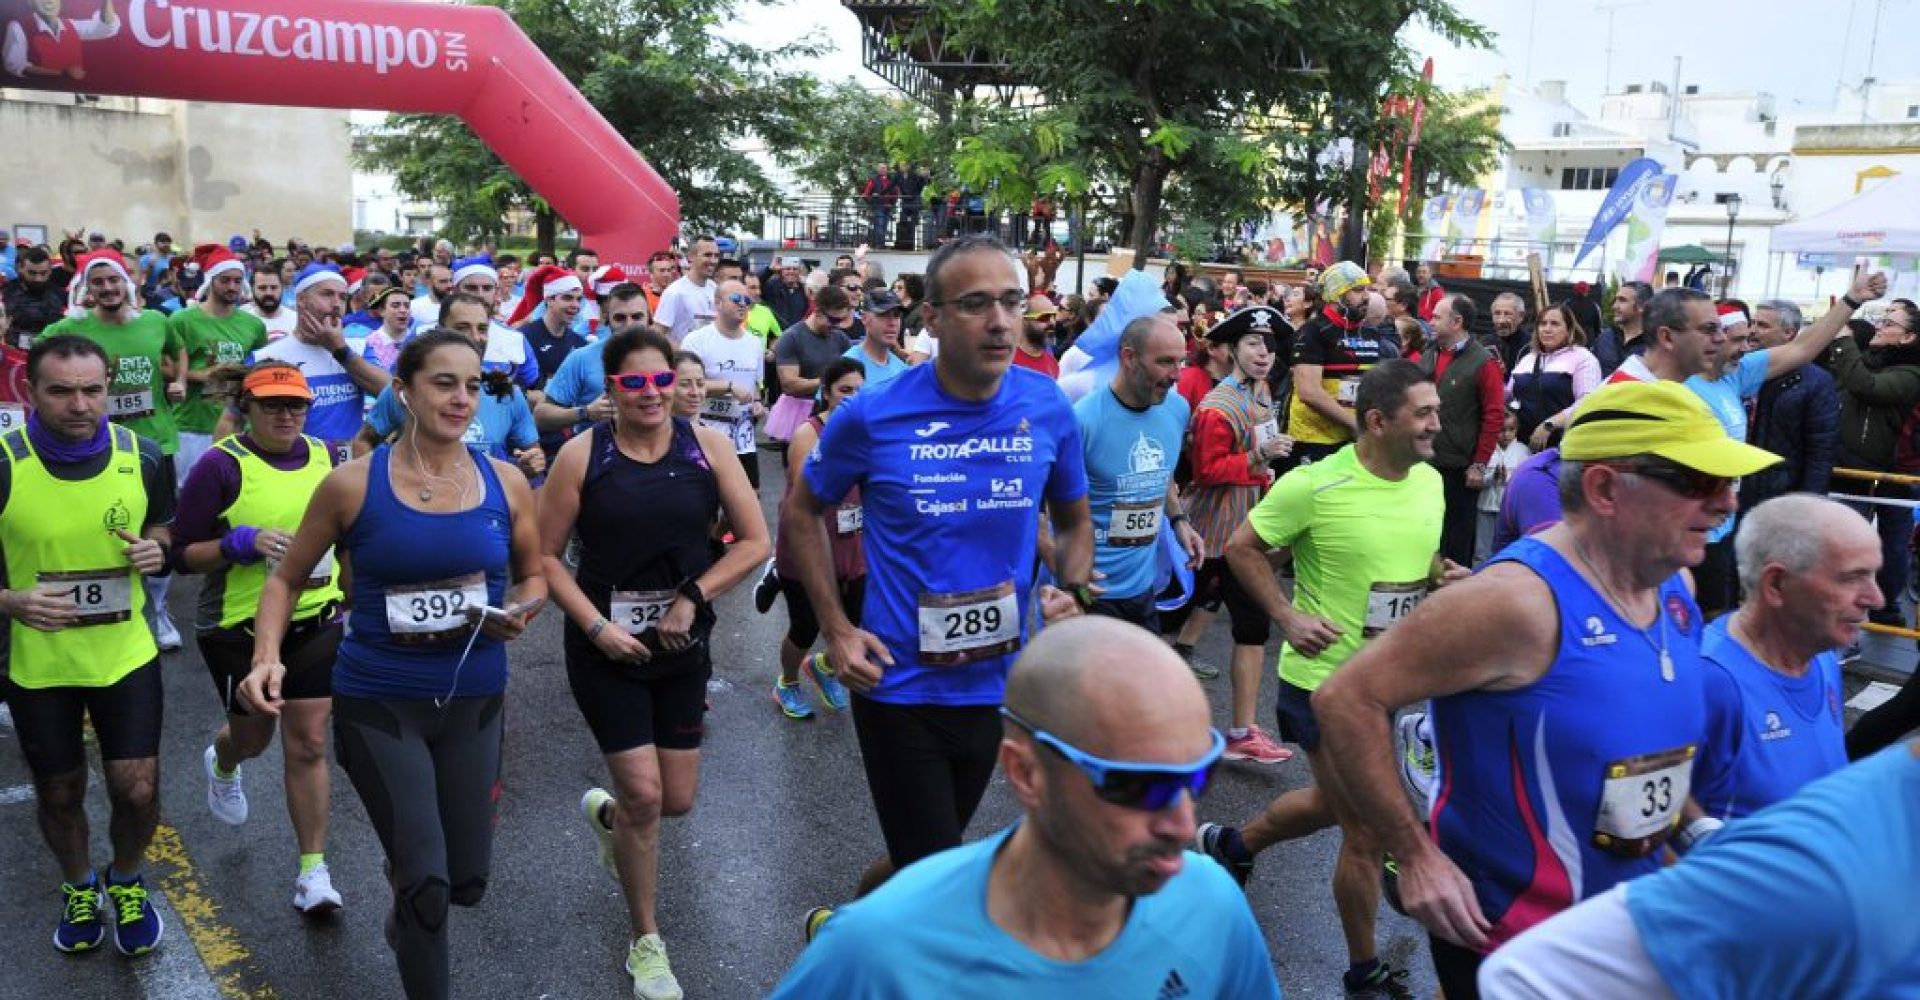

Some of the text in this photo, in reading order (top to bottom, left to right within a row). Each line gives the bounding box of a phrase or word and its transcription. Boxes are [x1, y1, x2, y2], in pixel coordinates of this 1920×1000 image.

[129, 0, 438, 74] Cruzcampo
[445, 31, 468, 72] SIN
[114, 395, 143, 410] 185
[709, 400, 732, 412] 287
[915, 498, 968, 516] Cajasol
[1125, 511, 1156, 530] 562
[71, 583, 103, 605] 18
[411, 590, 464, 622] 392
[944, 605, 1001, 640] 289
[1641, 776, 1672, 819] 33
